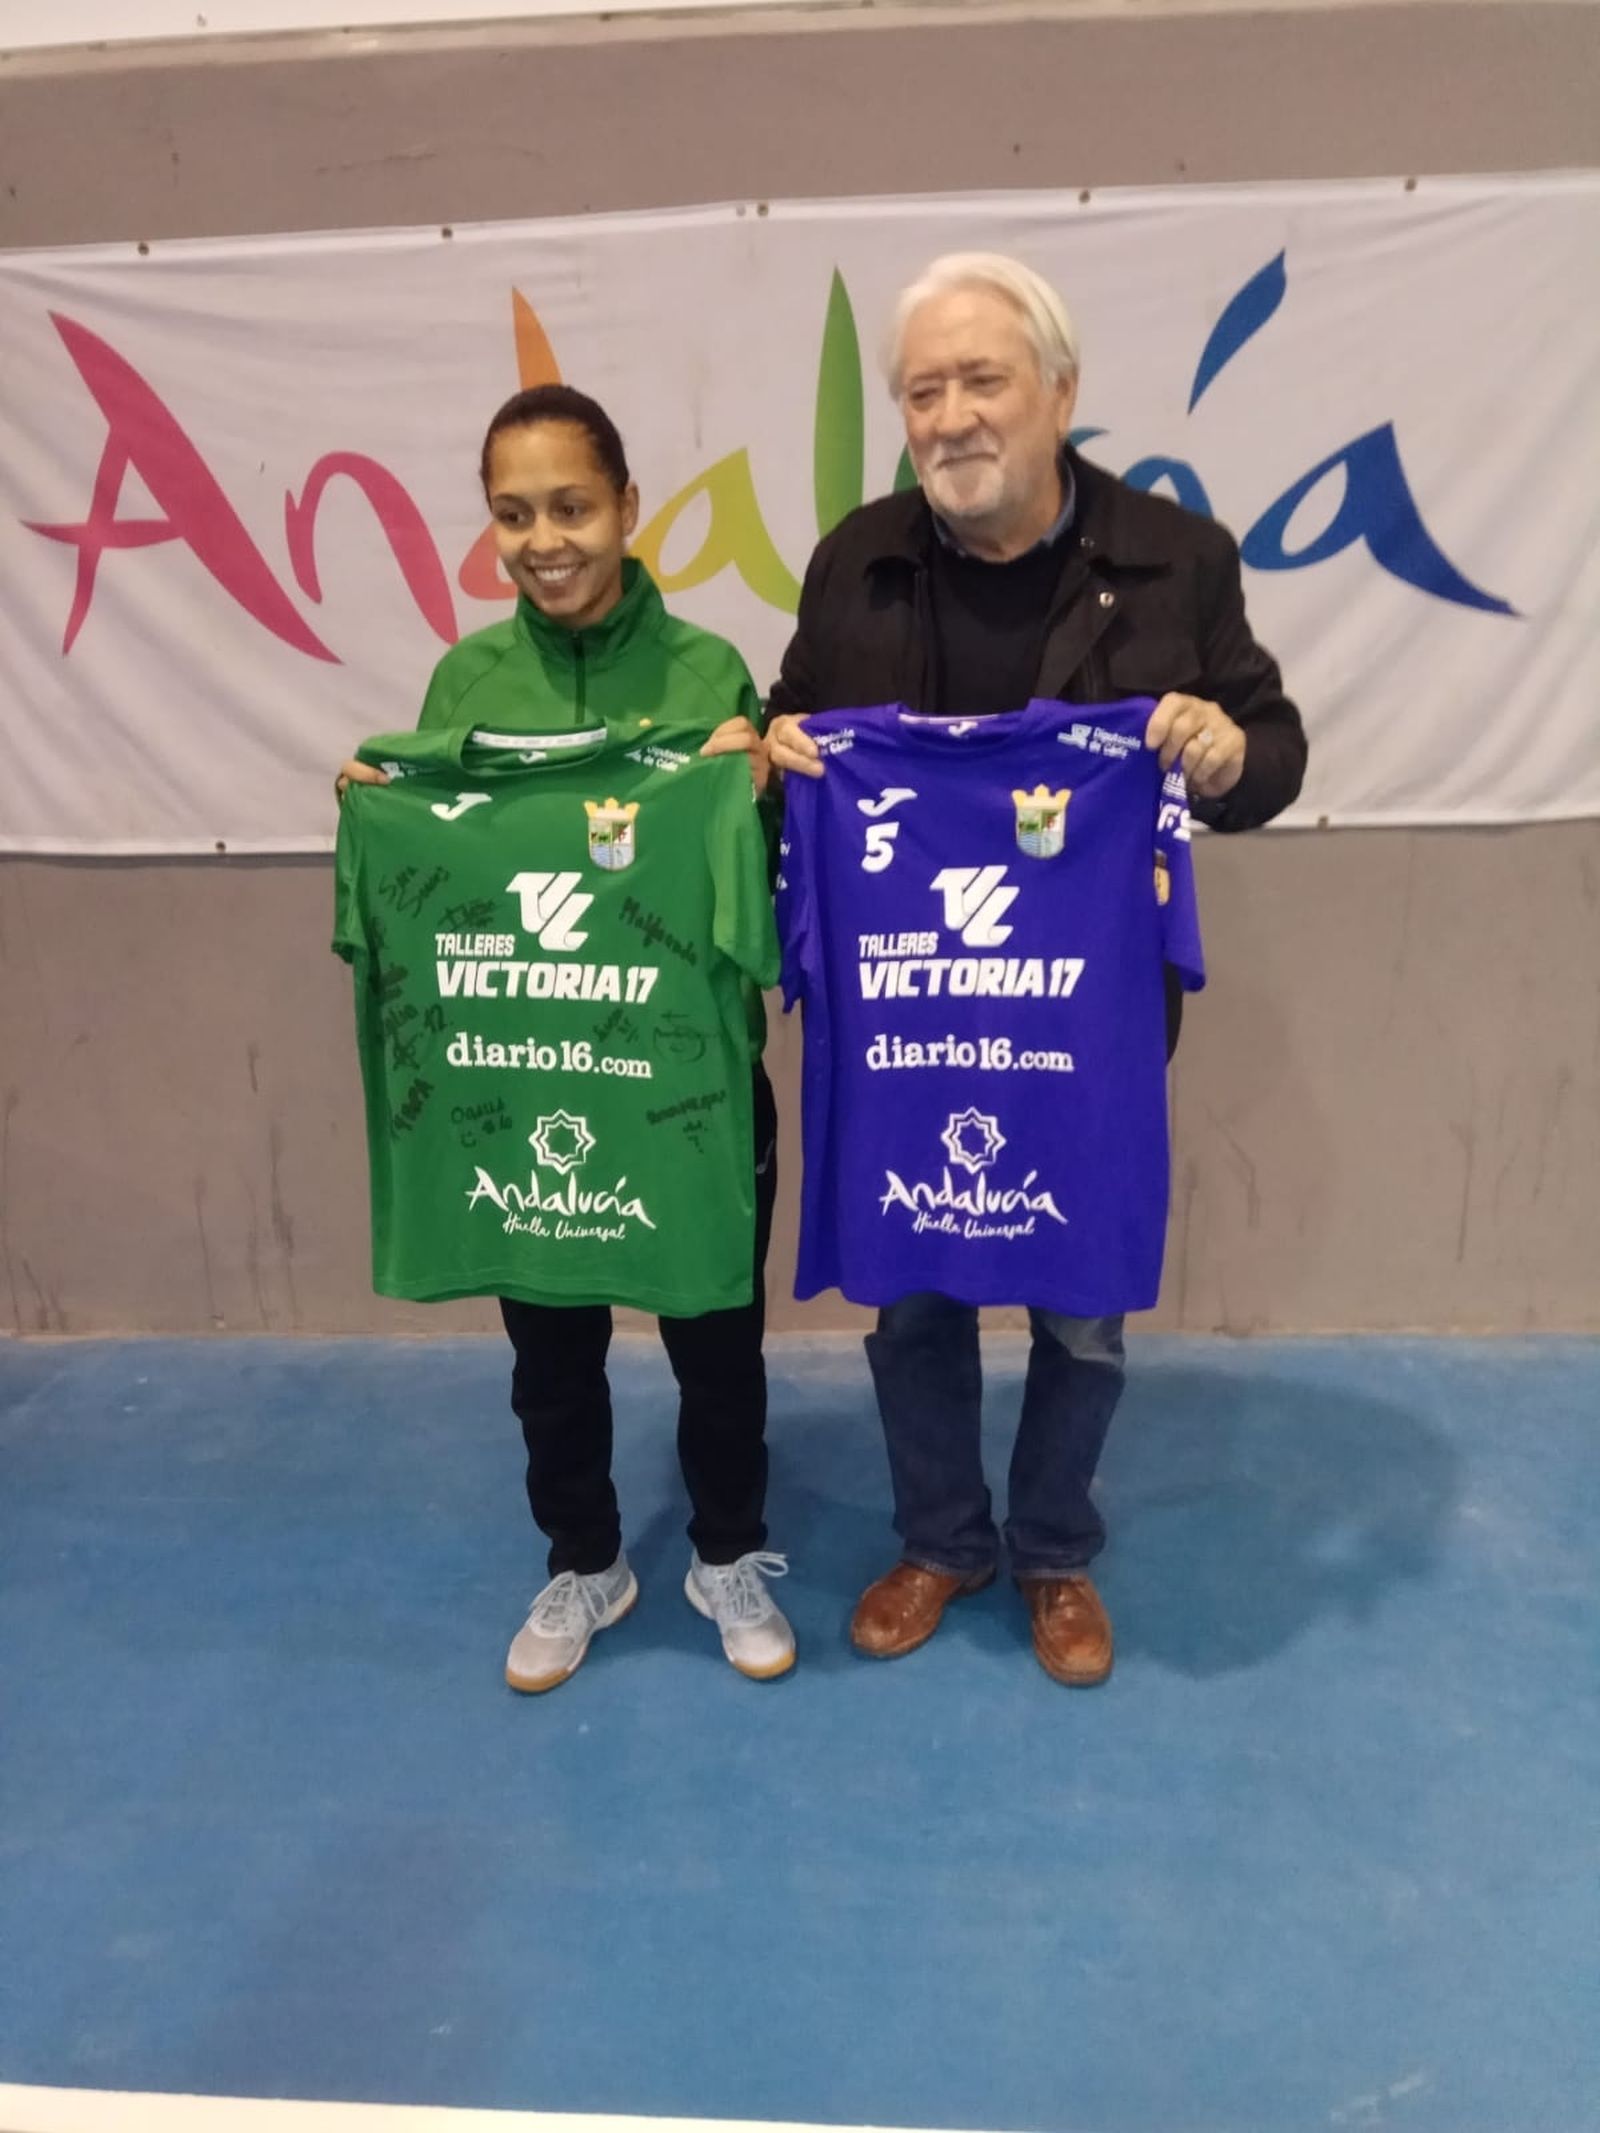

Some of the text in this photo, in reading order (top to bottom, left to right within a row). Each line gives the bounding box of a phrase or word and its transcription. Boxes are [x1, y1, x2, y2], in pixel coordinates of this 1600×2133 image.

[861, 821, 899, 873] 5
[435, 932, 516, 956] TALLERES
[858, 931, 939, 958] TALLERES
[465, 1166, 657, 1230] Andalucía
[879, 1166, 1068, 1225] Andalucía
[554, 1219, 626, 1243] Universal
[963, 1215, 1036, 1241] Universal
